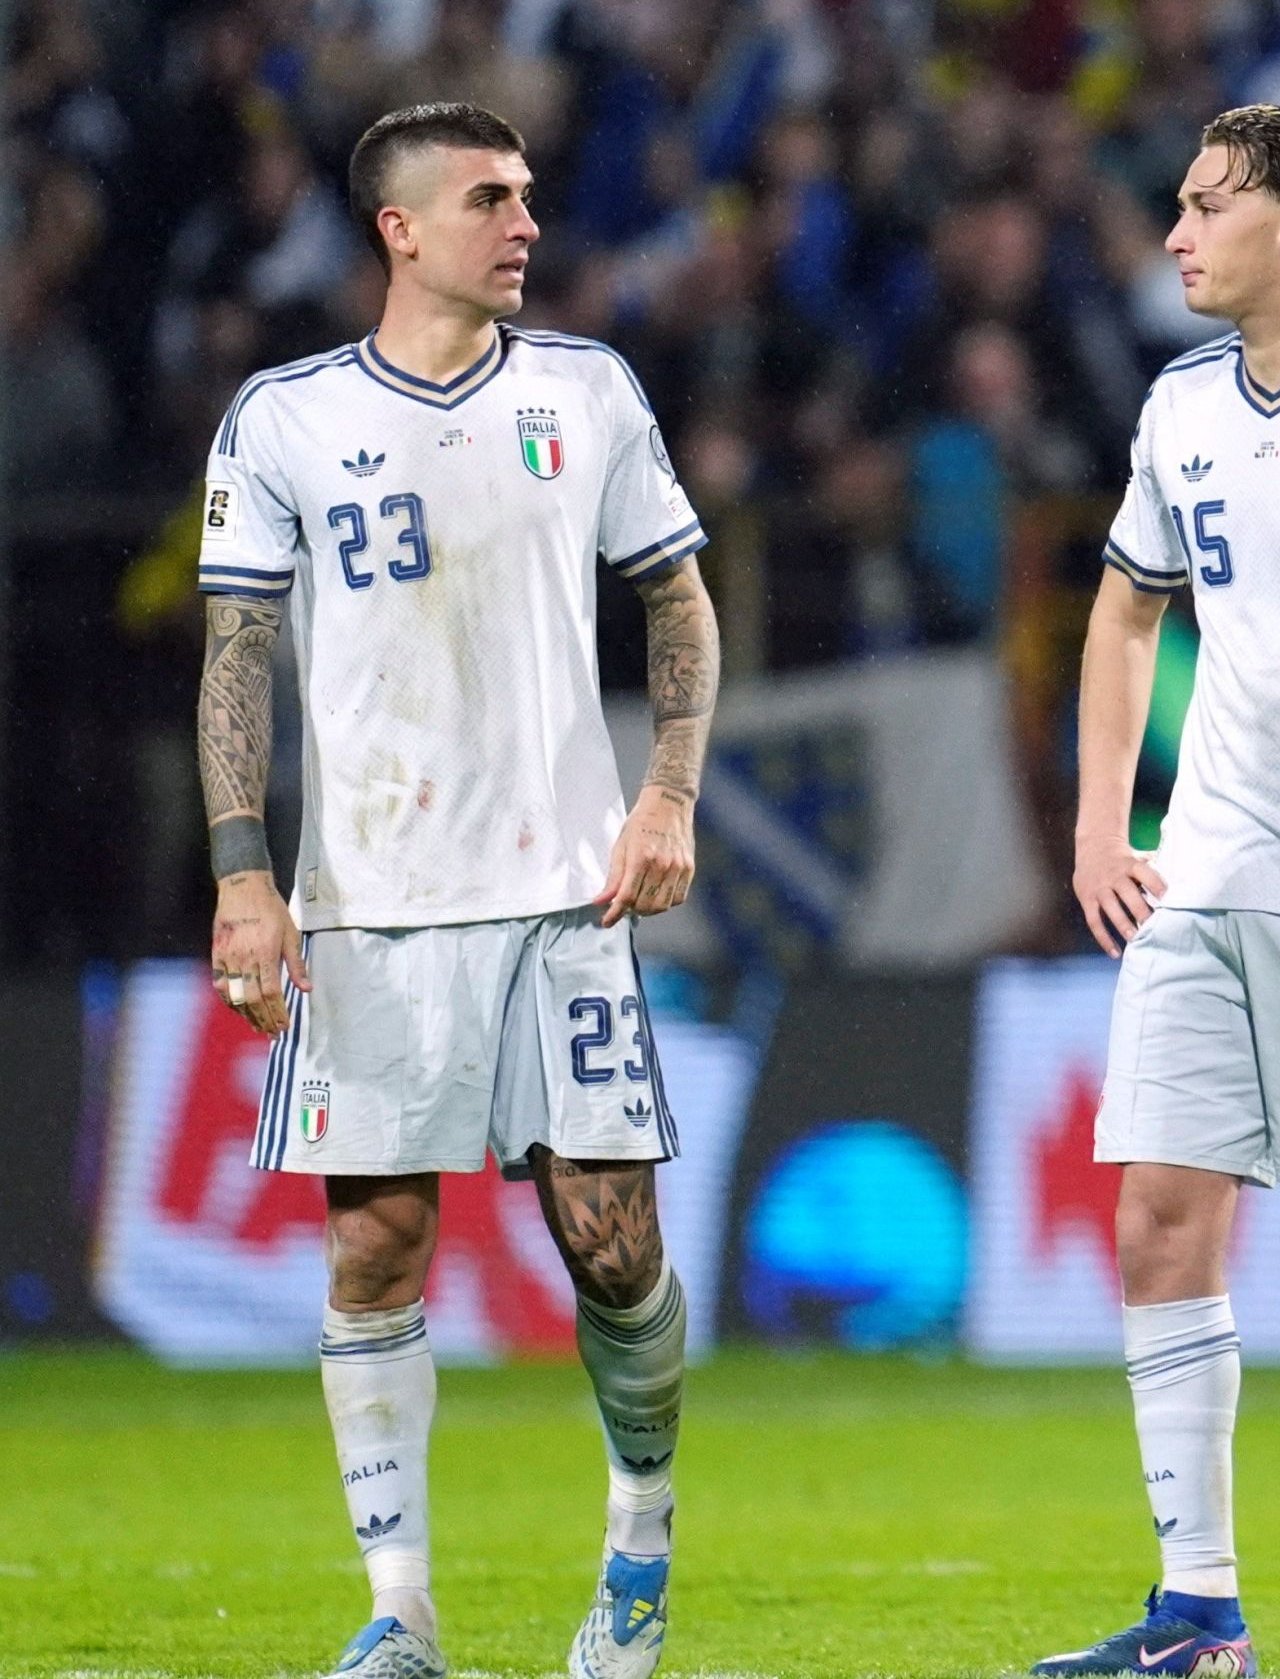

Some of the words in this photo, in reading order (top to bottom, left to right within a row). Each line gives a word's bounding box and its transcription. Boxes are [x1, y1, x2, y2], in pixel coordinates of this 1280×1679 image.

[521, 421, 558, 434] ITALIA
[327, 492, 434, 592] 23
[568, 995, 648, 1086] 23
